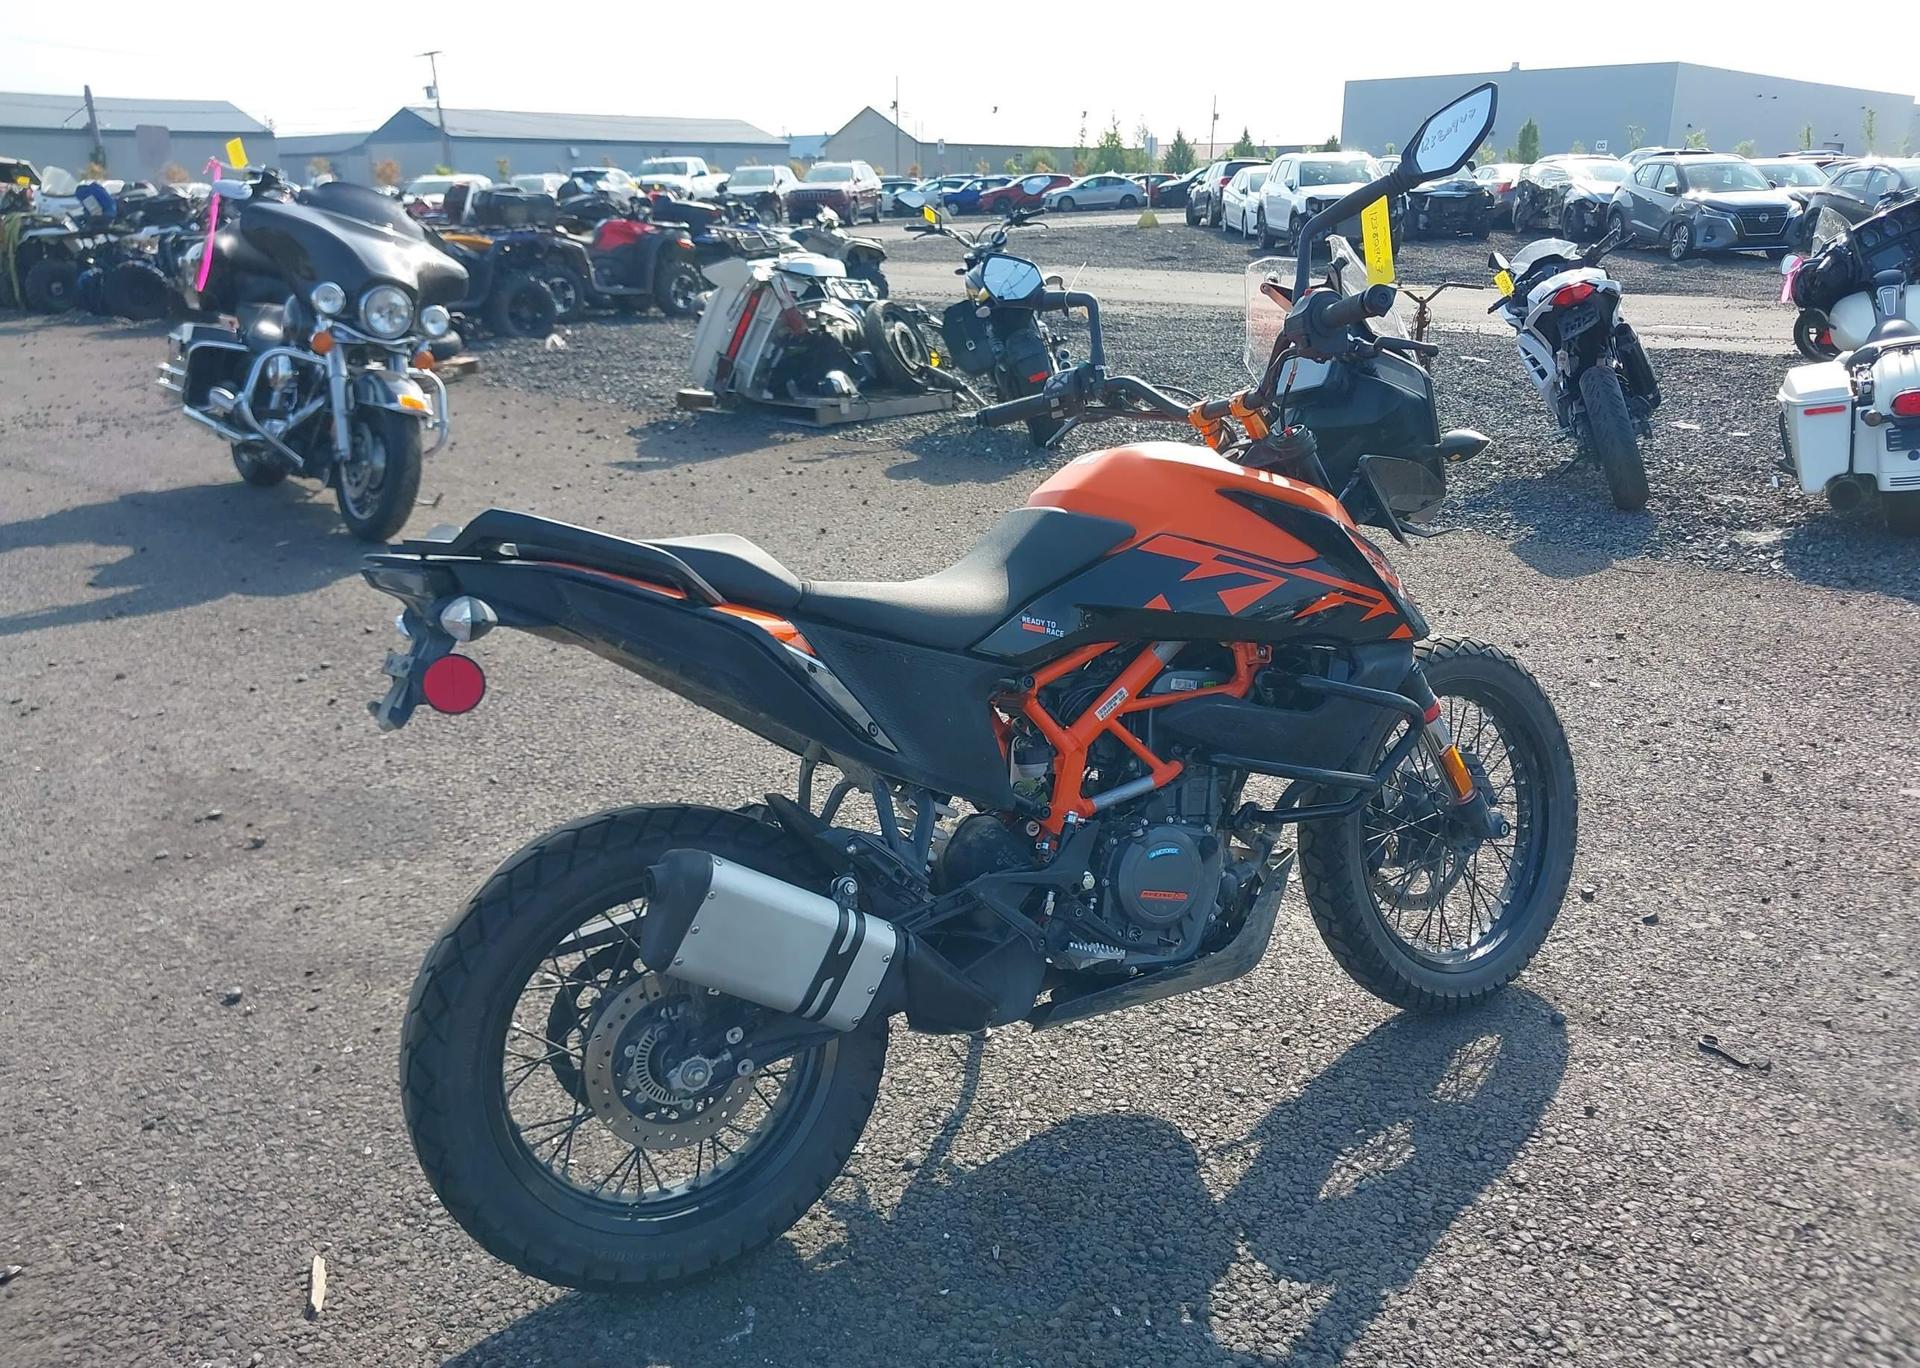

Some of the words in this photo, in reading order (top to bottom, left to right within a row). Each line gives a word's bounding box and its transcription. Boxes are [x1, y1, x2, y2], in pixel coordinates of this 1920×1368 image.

[1021, 615, 1046, 627] READY
[1046, 619, 1057, 628] TO
[1046, 627, 1065, 638] RACE
